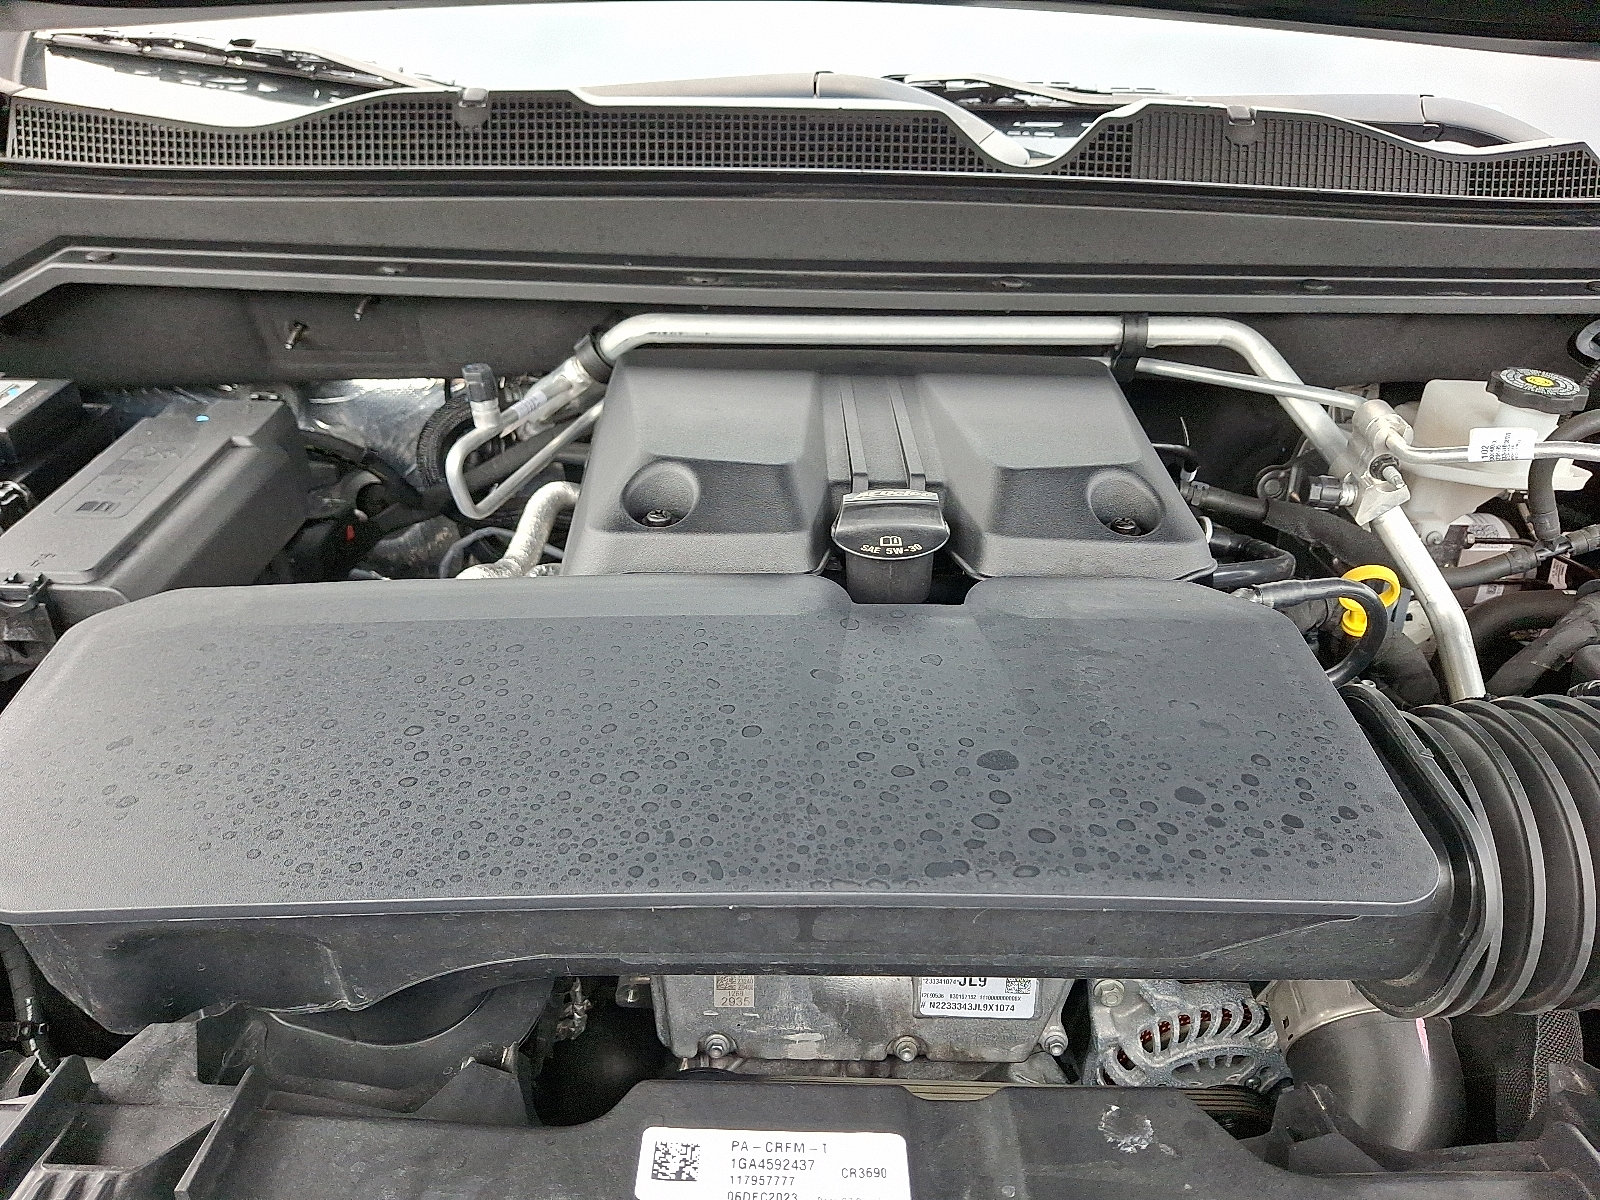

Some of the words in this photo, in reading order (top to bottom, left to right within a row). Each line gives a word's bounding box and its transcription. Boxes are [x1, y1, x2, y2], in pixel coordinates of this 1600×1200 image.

[860, 544, 882, 554] SAE
[886, 544, 922, 555] 5W-30
[959, 977, 987, 987] JL9
[722, 996, 750, 1006] 2935
[731, 1157, 815, 1171] 1GA4592437
[841, 1167, 888, 1179] CR3690
[730, 1175, 795, 1186] 117957777
